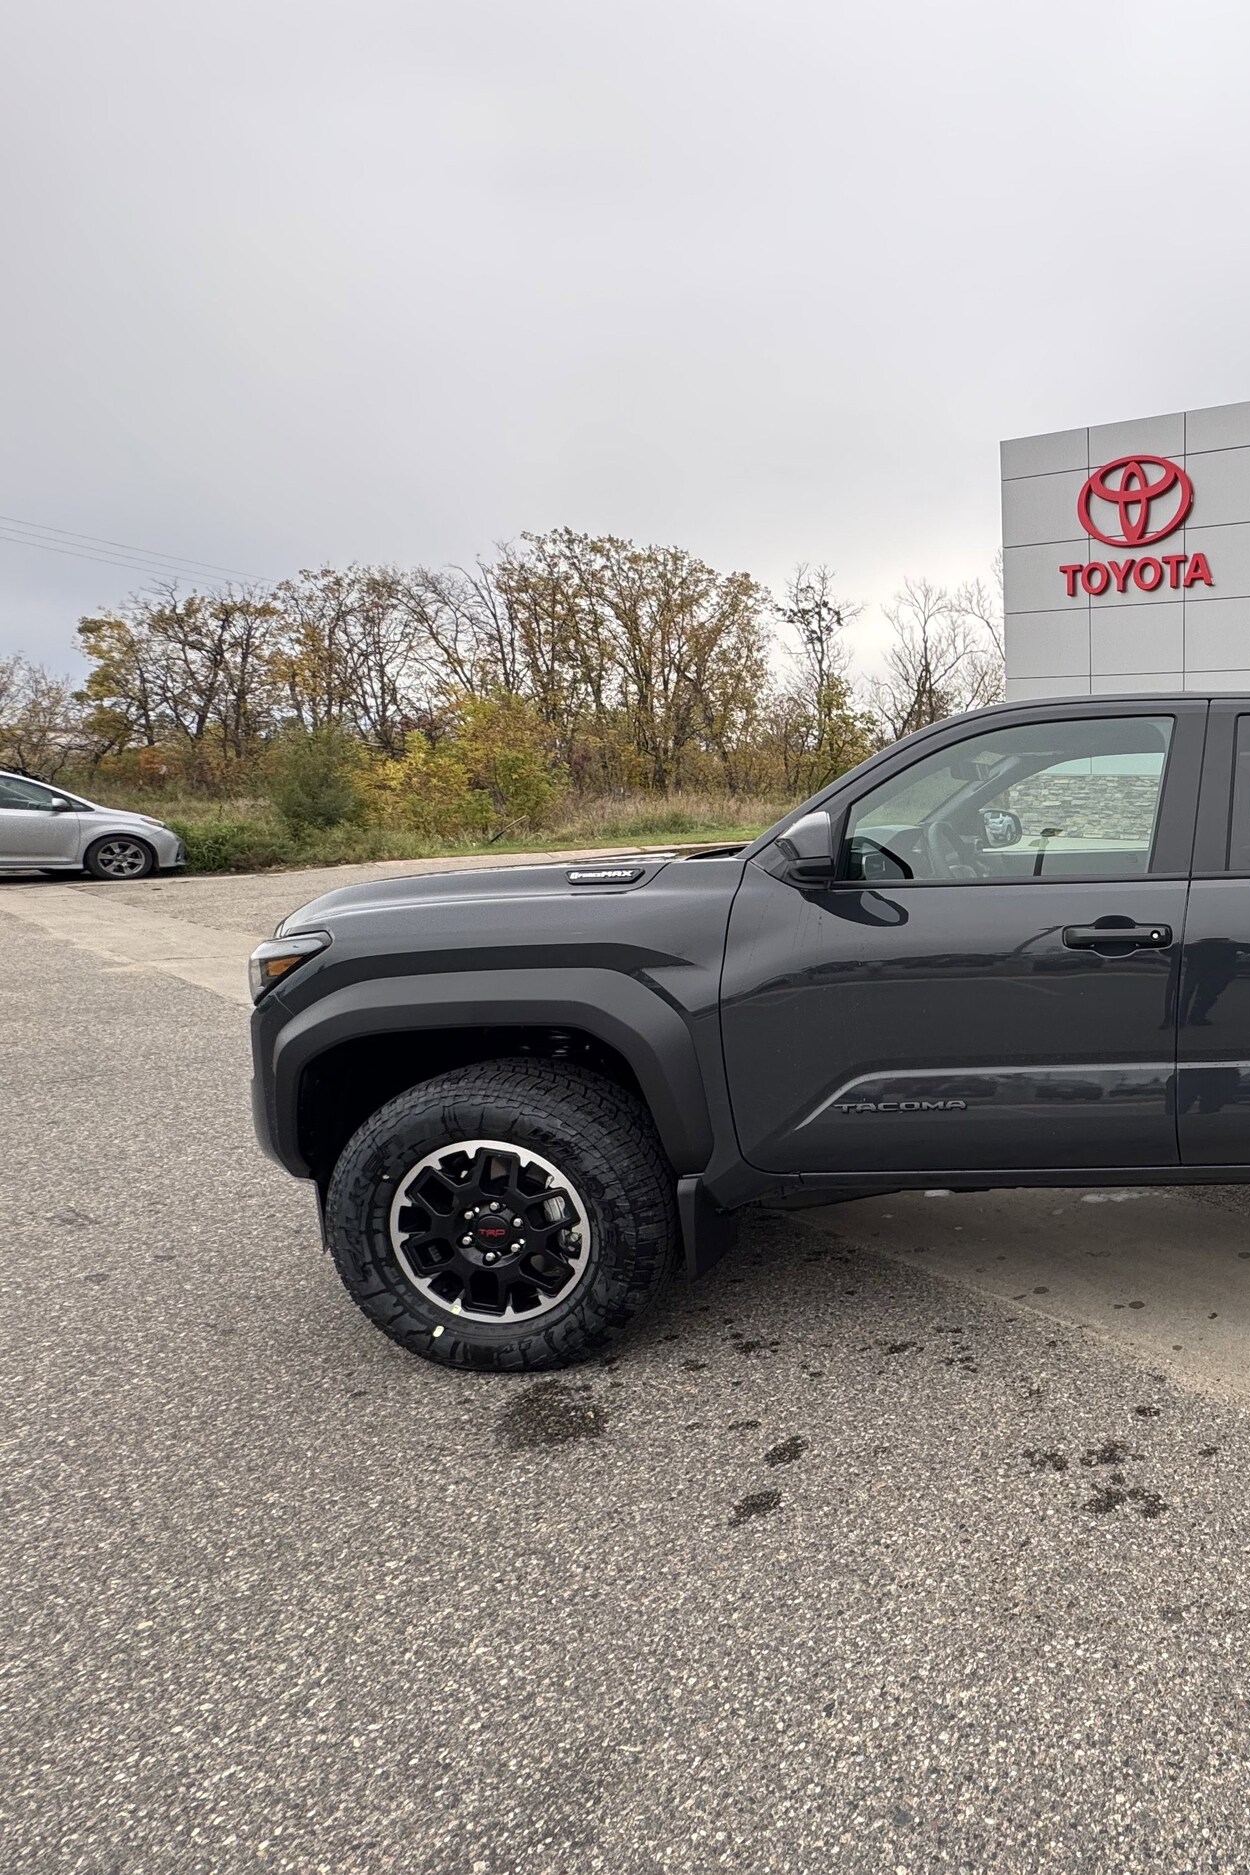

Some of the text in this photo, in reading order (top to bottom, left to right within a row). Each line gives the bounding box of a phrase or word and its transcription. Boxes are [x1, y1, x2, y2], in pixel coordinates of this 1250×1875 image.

[1059, 552, 1215, 597] TOYOTA
[834, 1100, 968, 1114] TACOMA
[478, 1229, 506, 1237] TRD
